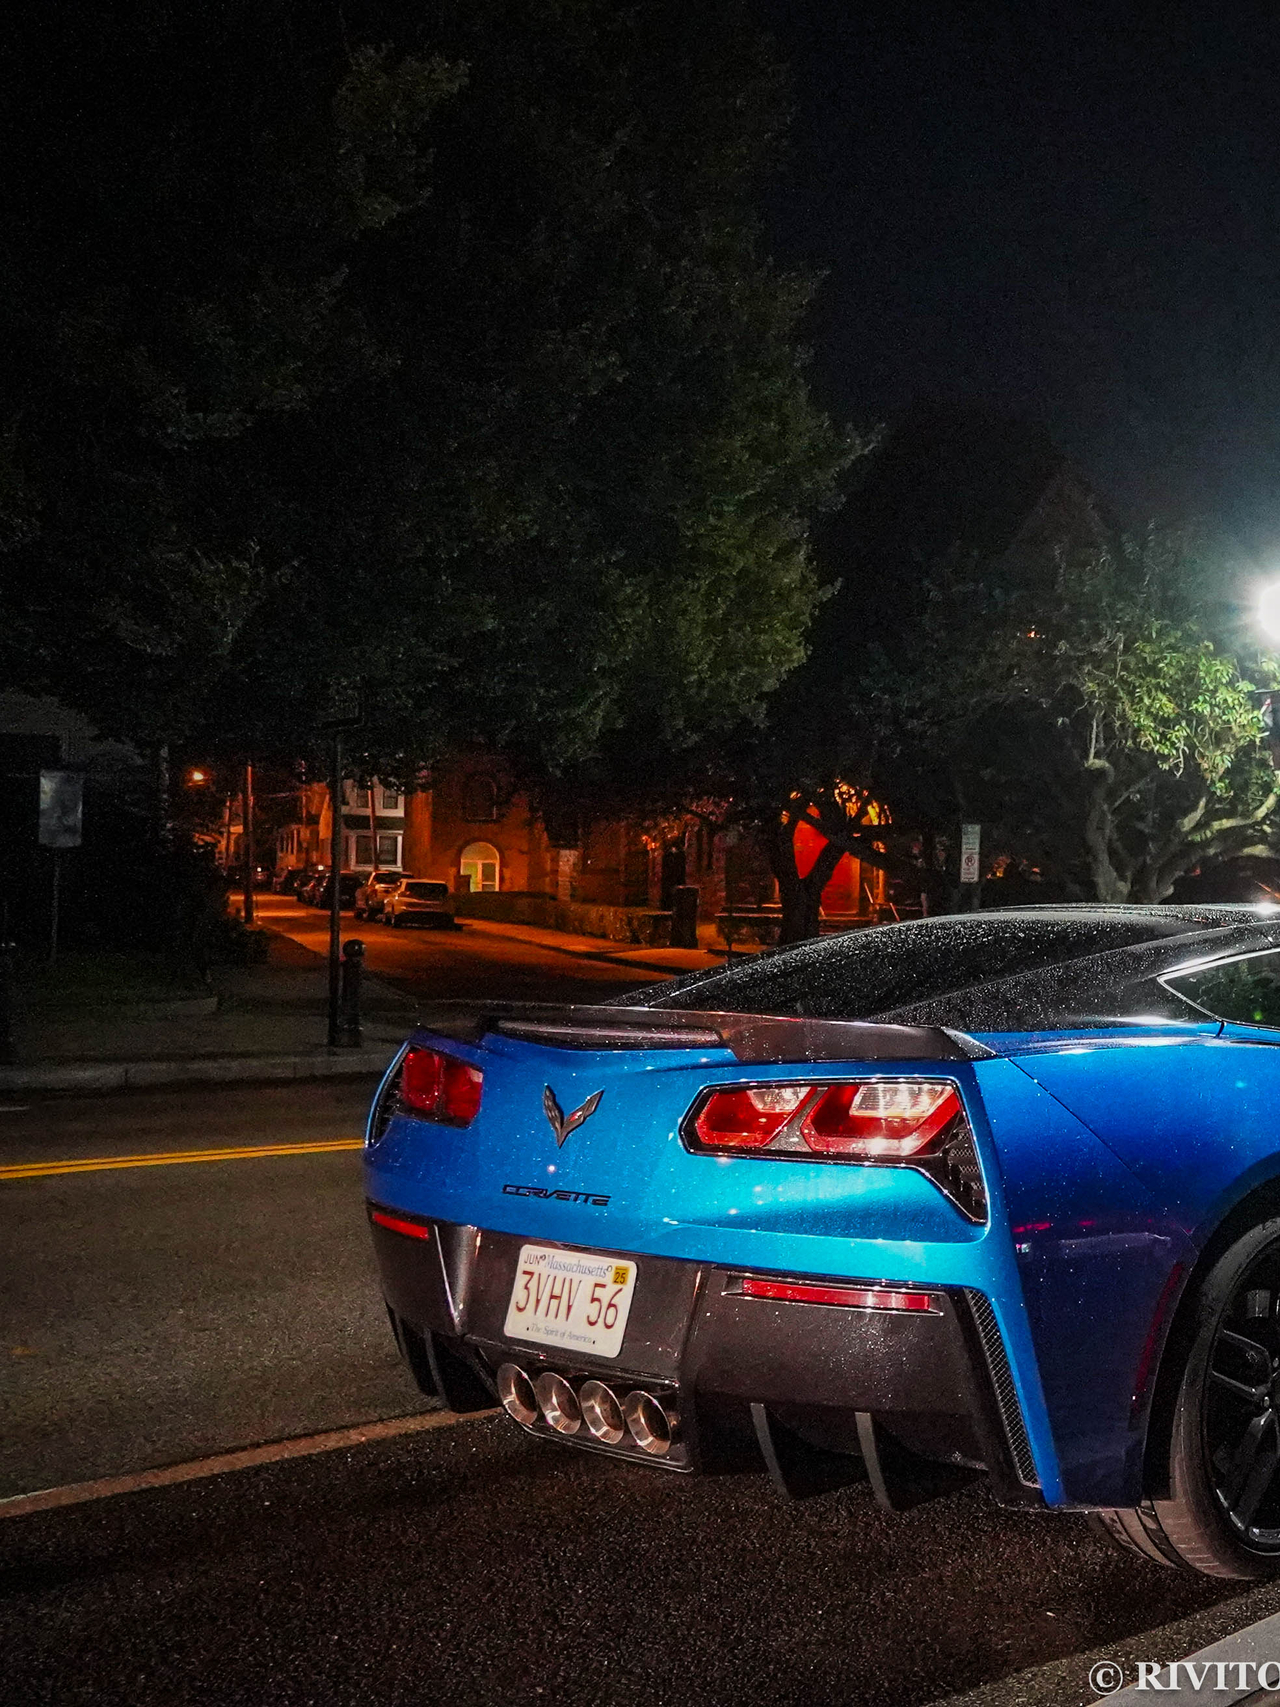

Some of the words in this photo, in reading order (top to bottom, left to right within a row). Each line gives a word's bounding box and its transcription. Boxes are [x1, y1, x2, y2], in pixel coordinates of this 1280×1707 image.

[502, 1184, 612, 1207] CORVETTE
[523, 1253, 541, 1266] JUN
[545, 1254, 608, 1279] Massachusetts
[613, 1271, 627, 1285] 25
[515, 1270, 583, 1322] 3VHV
[586, 1282, 624, 1330] 56
[530, 1323, 542, 1333] The
[543, 1326, 560, 1337] Spirit
[566, 1331, 592, 1344] America
